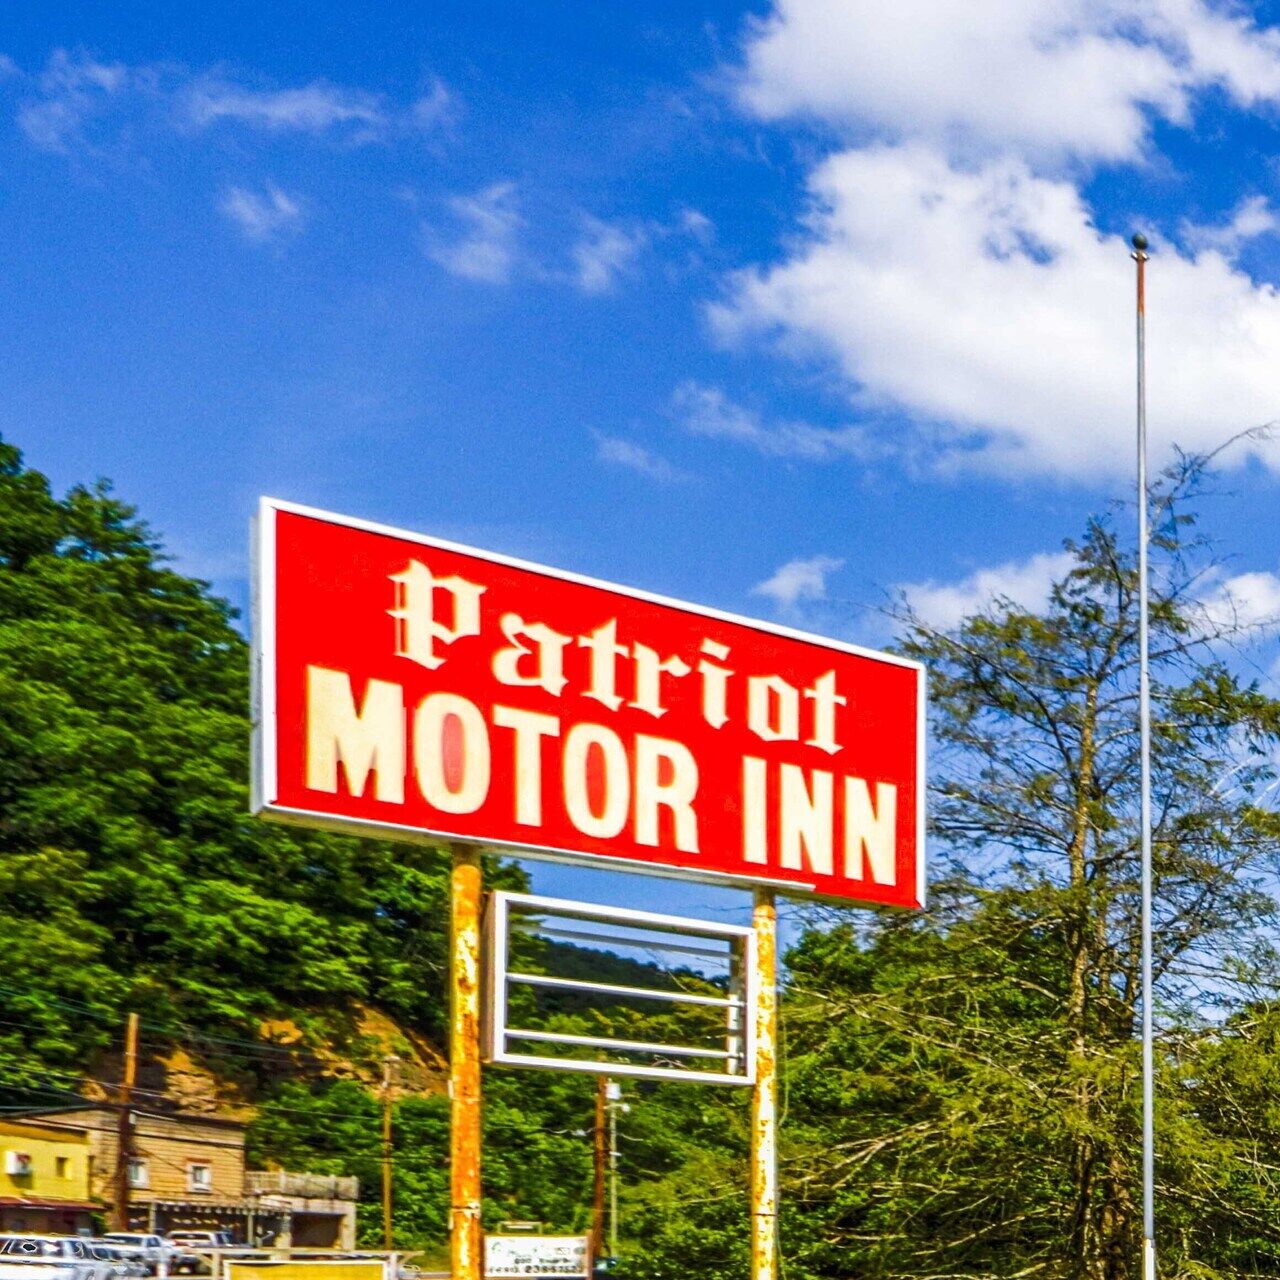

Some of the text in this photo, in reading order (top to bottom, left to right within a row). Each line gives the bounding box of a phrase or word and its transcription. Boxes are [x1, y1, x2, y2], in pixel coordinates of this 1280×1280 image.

[386, 557, 847, 755] Patriot
[304, 663, 897, 886] MOTOR INN
